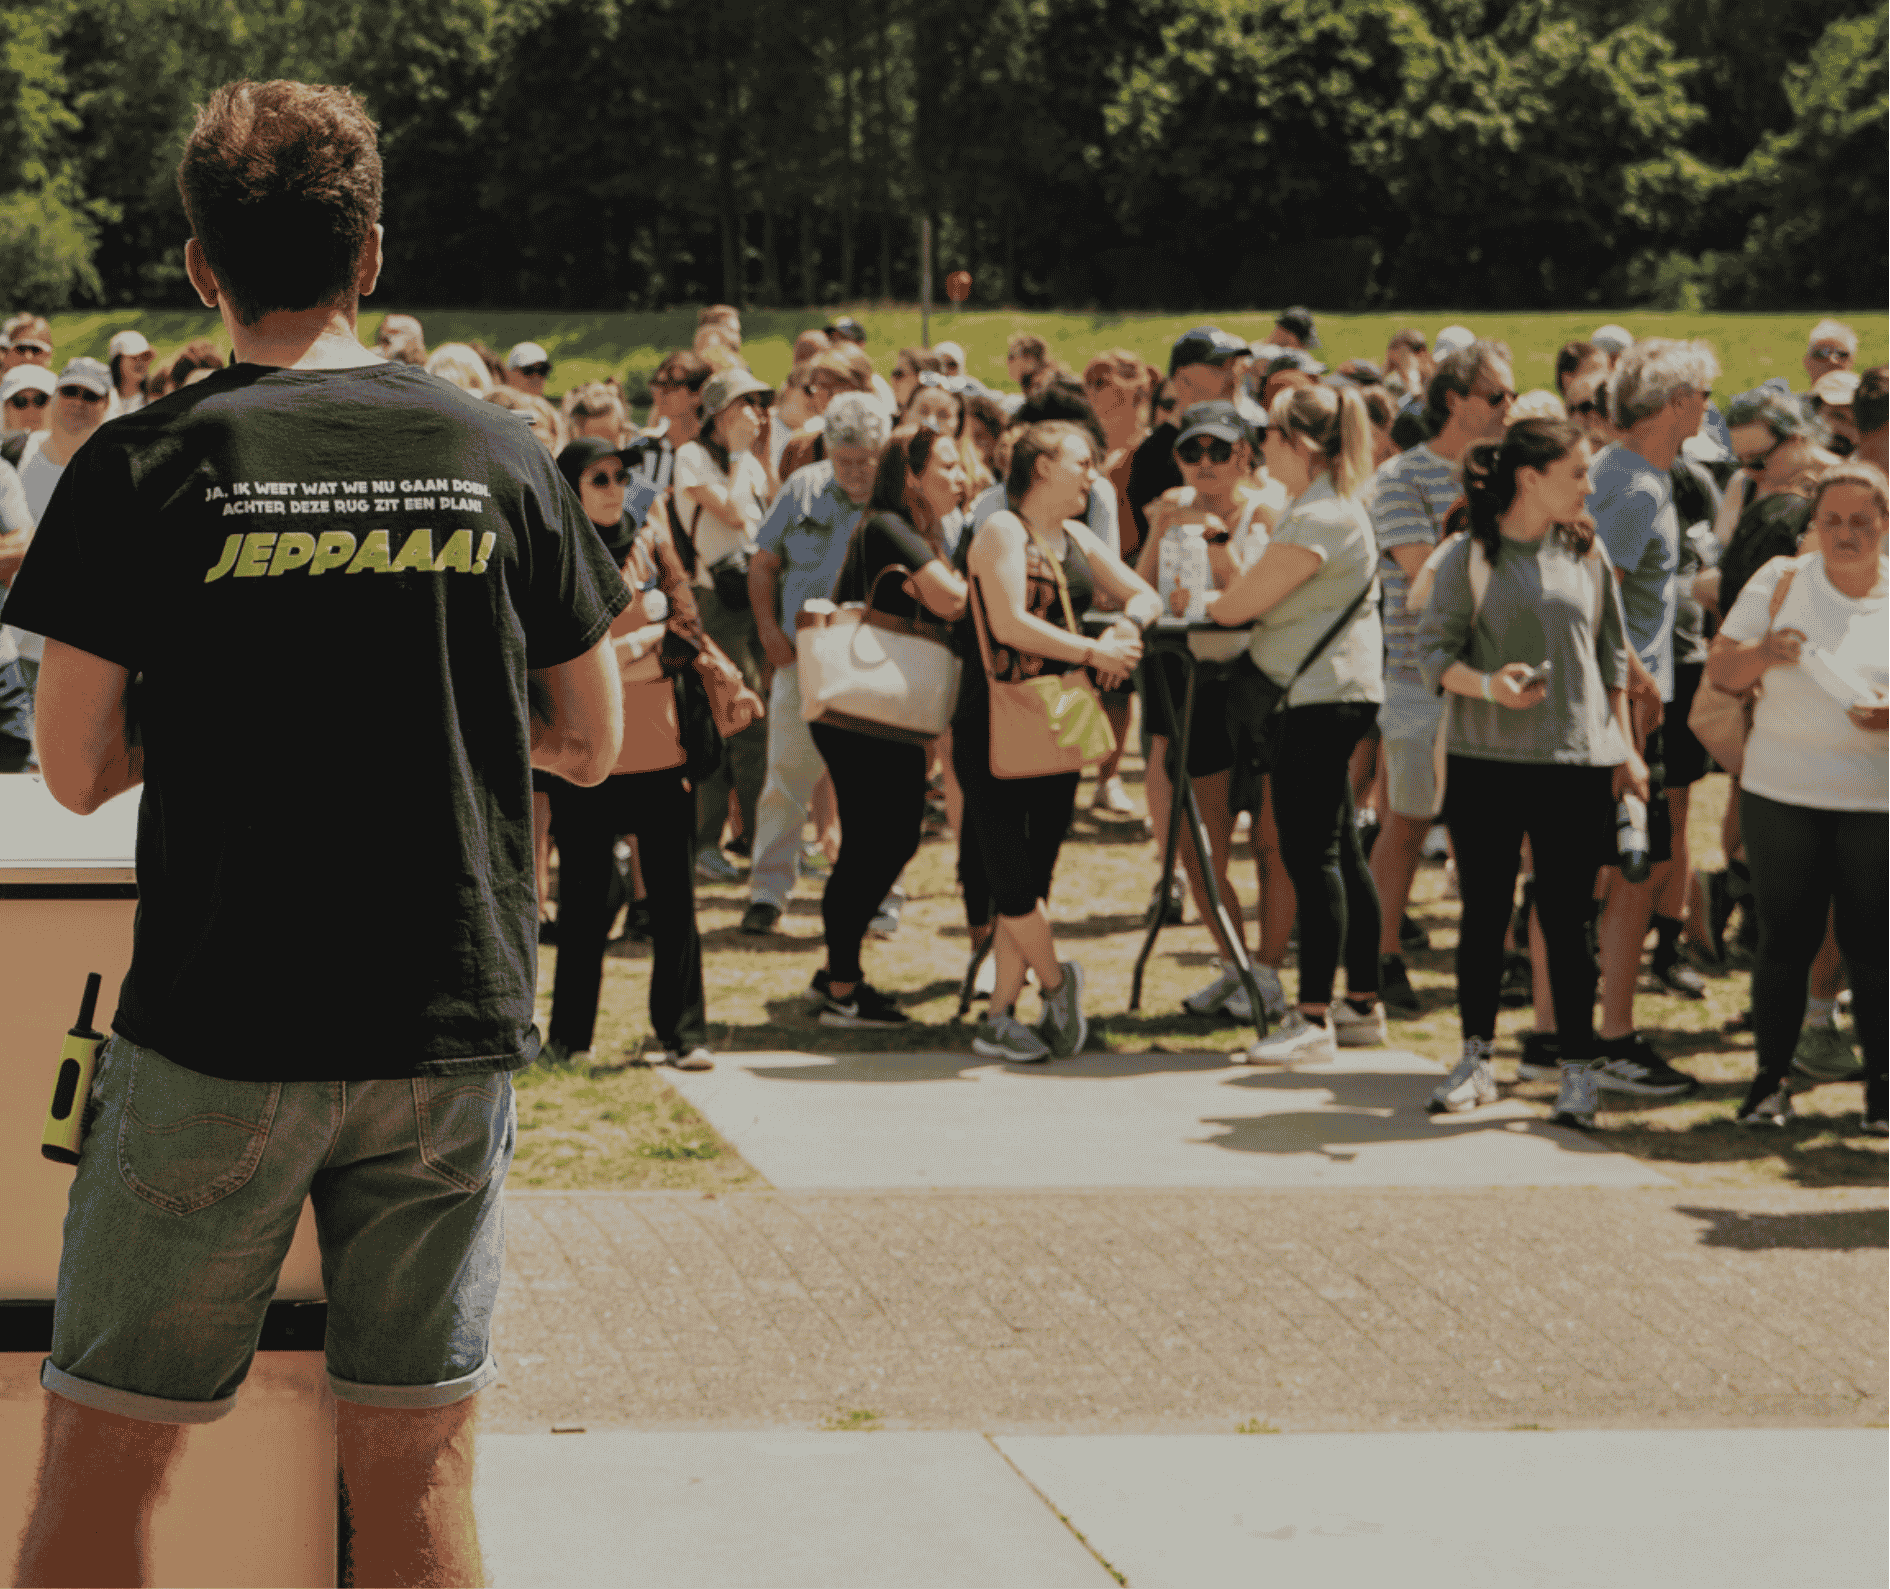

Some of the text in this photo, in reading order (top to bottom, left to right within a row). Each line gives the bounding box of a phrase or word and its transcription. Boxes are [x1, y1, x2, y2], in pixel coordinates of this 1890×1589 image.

[233, 482, 251, 496] IK
[253, 481, 297, 496] WEET
[301, 482, 338, 496] WAT
[341, 480, 368, 494] WE
[371, 480, 396, 493] NU
[399, 478, 449, 493] GAAN
[222, 500, 286, 516] ACHTER
[290, 500, 329, 513] DEZE
[334, 499, 370, 514] RUG
[374, 498, 400, 512] ZIT
[404, 497, 435, 510] EEN
[204, 529, 497, 583] JEPPAAA!
